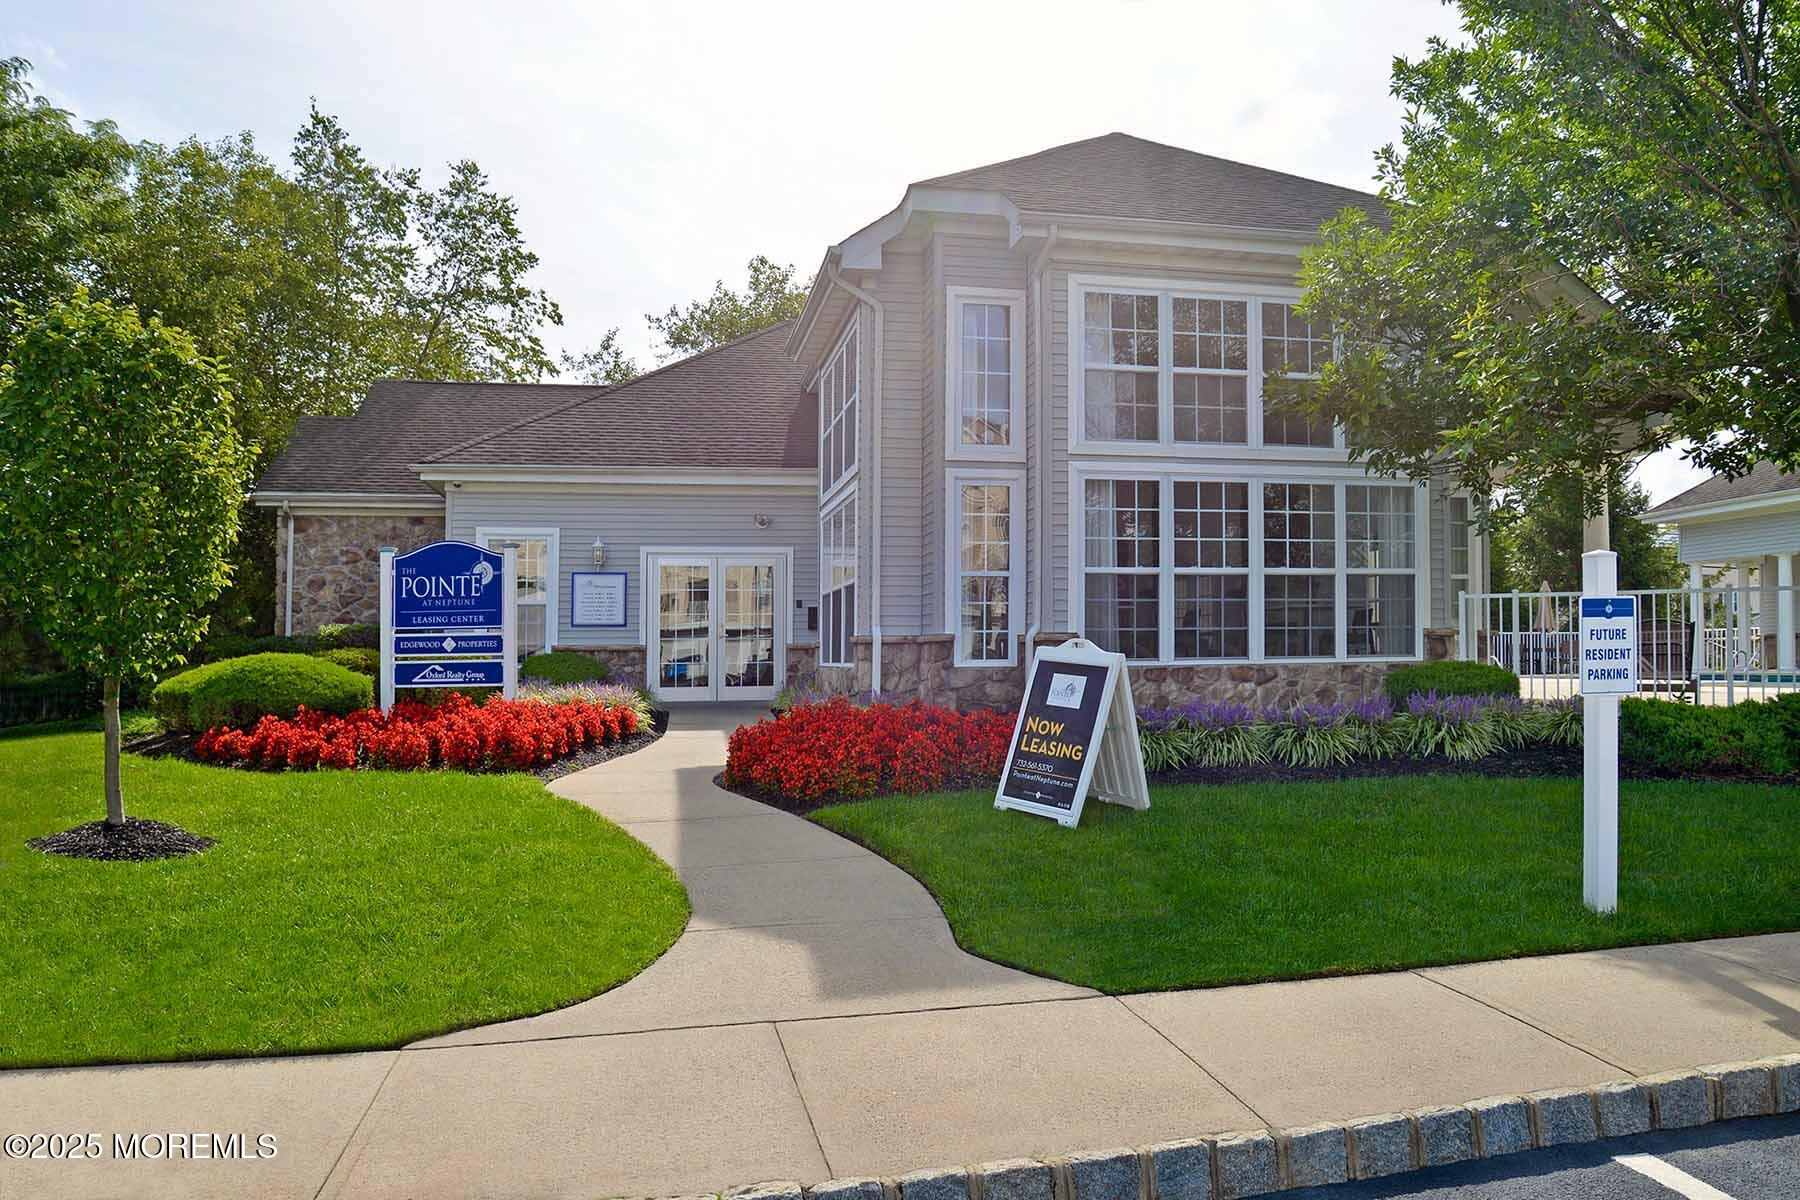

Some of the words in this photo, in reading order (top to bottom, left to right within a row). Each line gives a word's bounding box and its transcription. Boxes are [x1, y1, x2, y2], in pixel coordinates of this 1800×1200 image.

[402, 567, 416, 575] THE
[401, 575, 481, 598] POINTE
[422, 599, 433, 607] AT
[435, 598, 476, 606] NEPTUNE
[412, 616, 448, 624] LEASING
[450, 615, 485, 623] CENTER
[1590, 628, 1627, 640] FUTURE
[400, 641, 441, 649] EDGEWOOD
[457, 640, 498, 648] PROPERTIES
[1585, 648, 1631, 660] RESIDENT
[1588, 668, 1629, 680] PARKING
[1021, 734, 1083, 760] LEASING
